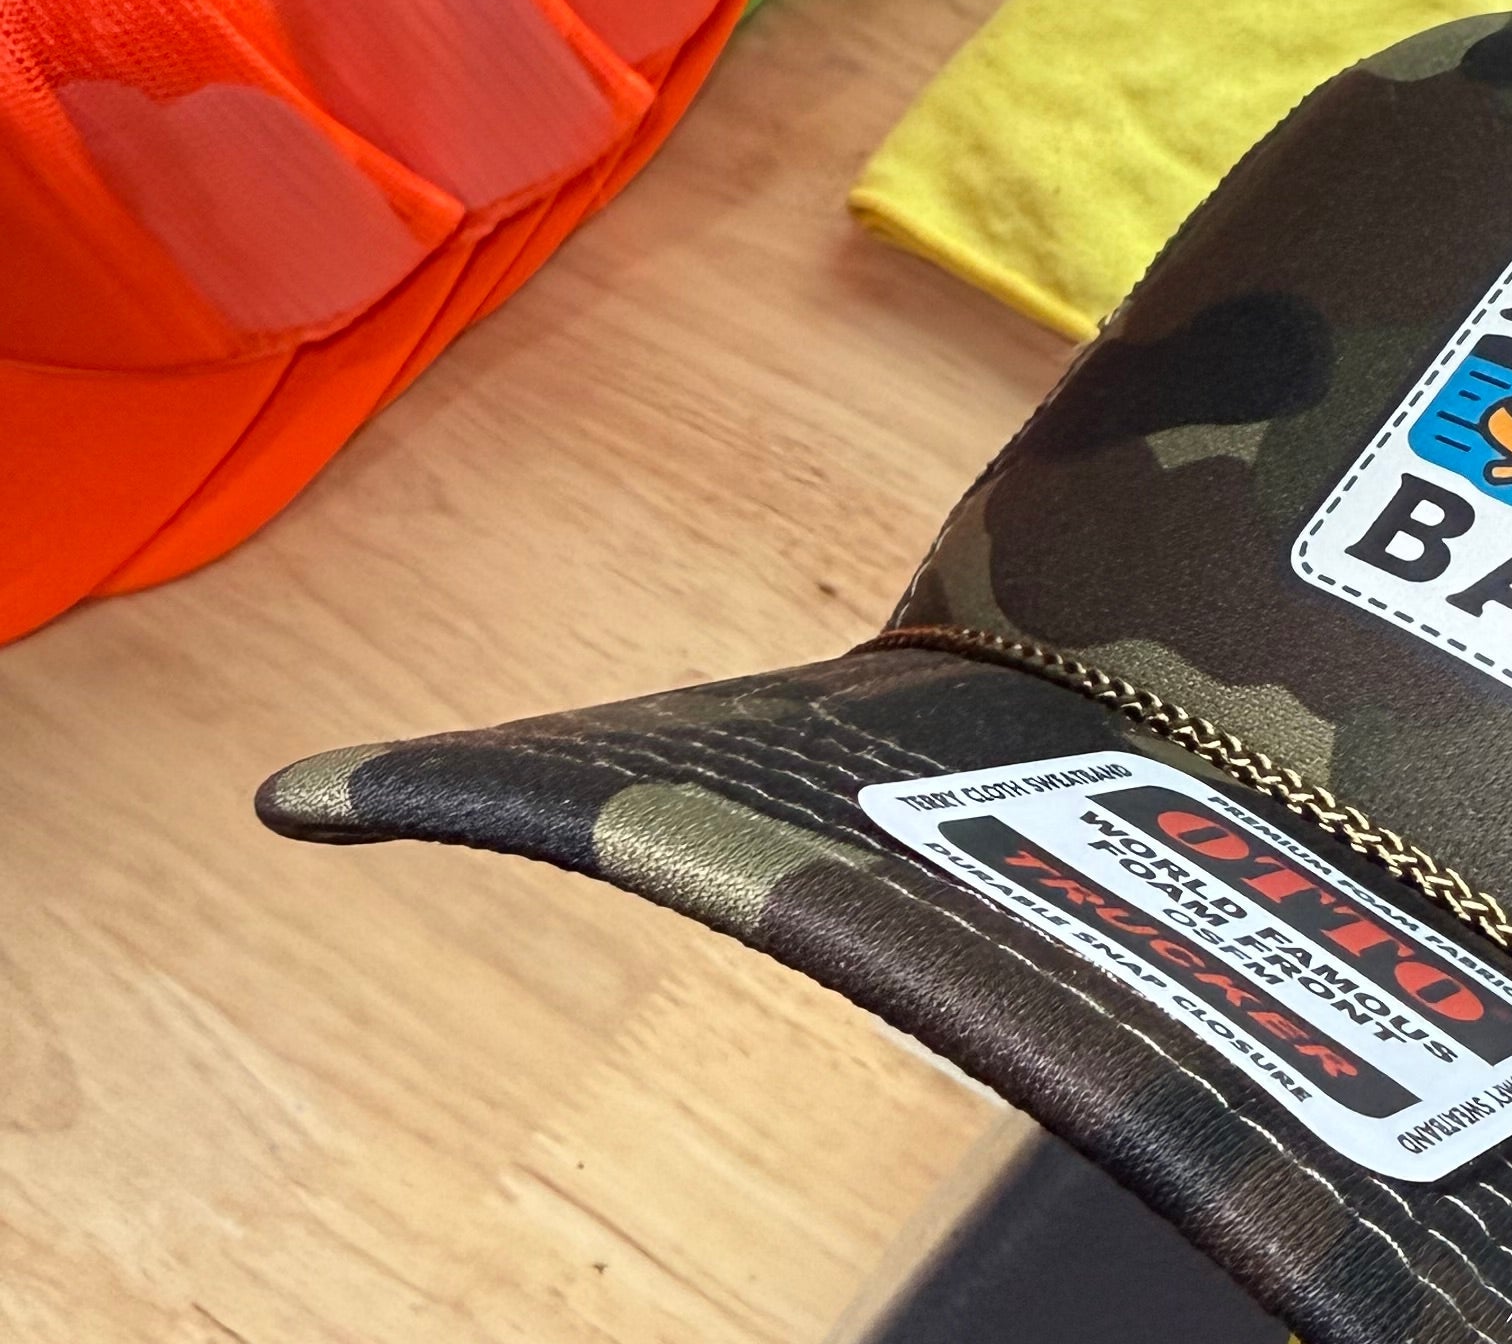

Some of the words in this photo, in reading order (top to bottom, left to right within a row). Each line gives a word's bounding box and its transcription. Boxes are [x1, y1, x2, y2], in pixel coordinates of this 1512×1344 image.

[895, 789, 967, 812] TERRY
[960, 779, 1032, 804] CLOTH
[1021, 763, 1133, 794] SWEATBAND
[1207, 796, 1333, 876] PREMIUM
[1337, 879, 1420, 932] FOAM
[923, 842, 1072, 927] DURABLE
[1070, 931, 1168, 988] SNAP
[1171, 995, 1313, 1103] CLOSURE
[1004, 849, 1359, 1078] TRUCKER
[1079, 810, 1248, 919] WORLD
[1255, 926, 1459, 1064] FAMOUS
[1087, 839, 1230, 927] FOAM
[1233, 934, 1408, 1043] FRONT
[1156, 810, 1485, 1022] OTTO
[1162, 908, 1285, 986] OSFM
[1396, 1096, 1497, 1155] SWEATBAND
